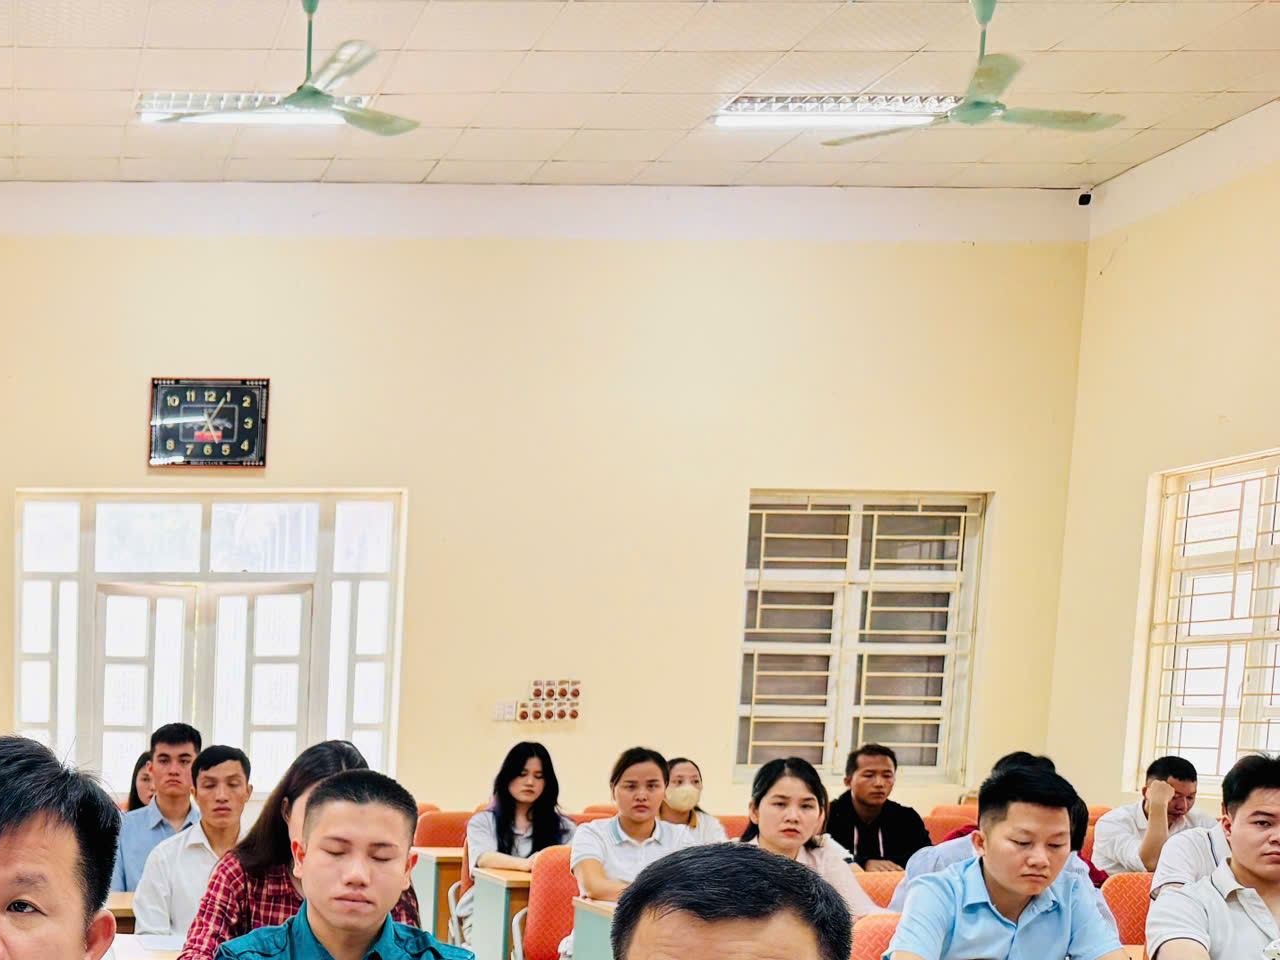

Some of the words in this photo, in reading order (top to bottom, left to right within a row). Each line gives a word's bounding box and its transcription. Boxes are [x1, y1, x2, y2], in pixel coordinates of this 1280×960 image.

[167, 395, 180, 407] 10
[186, 391, 196, 402] 11
[204, 391, 217, 402] 12
[226, 391, 232, 402] 1
[242, 396, 252, 408] 2
[244, 418, 253, 430] 3
[166, 440, 176, 451] 8
[186, 444, 195, 456] 7
[203, 444, 213, 456] 6
[222, 444, 231, 456] 5
[241, 440, 249, 452] 4
